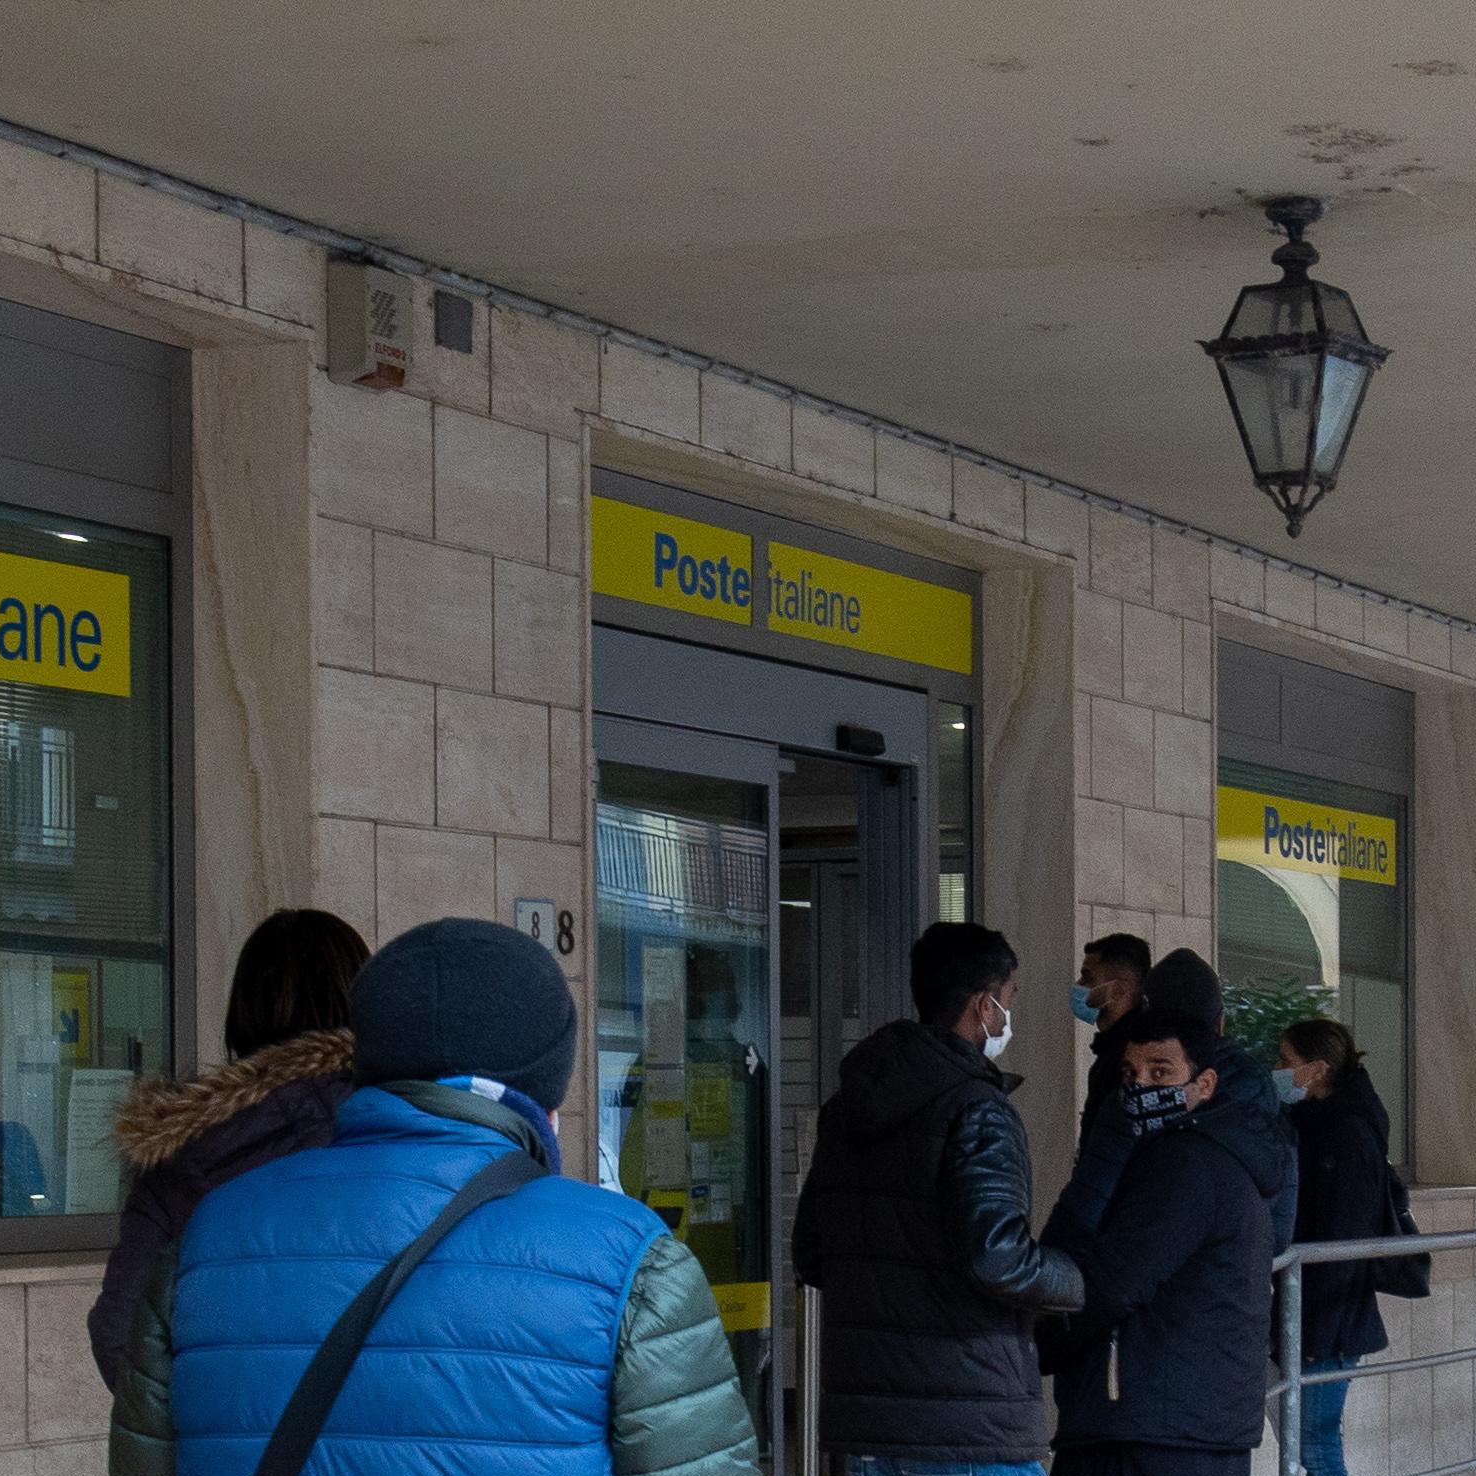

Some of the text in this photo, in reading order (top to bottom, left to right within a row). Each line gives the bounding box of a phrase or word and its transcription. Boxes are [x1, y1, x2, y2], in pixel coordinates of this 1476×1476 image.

[1264, 806, 1388, 873] Posteitaliane
[531, 910, 541, 940] 8
[556, 910, 575, 956] 8
